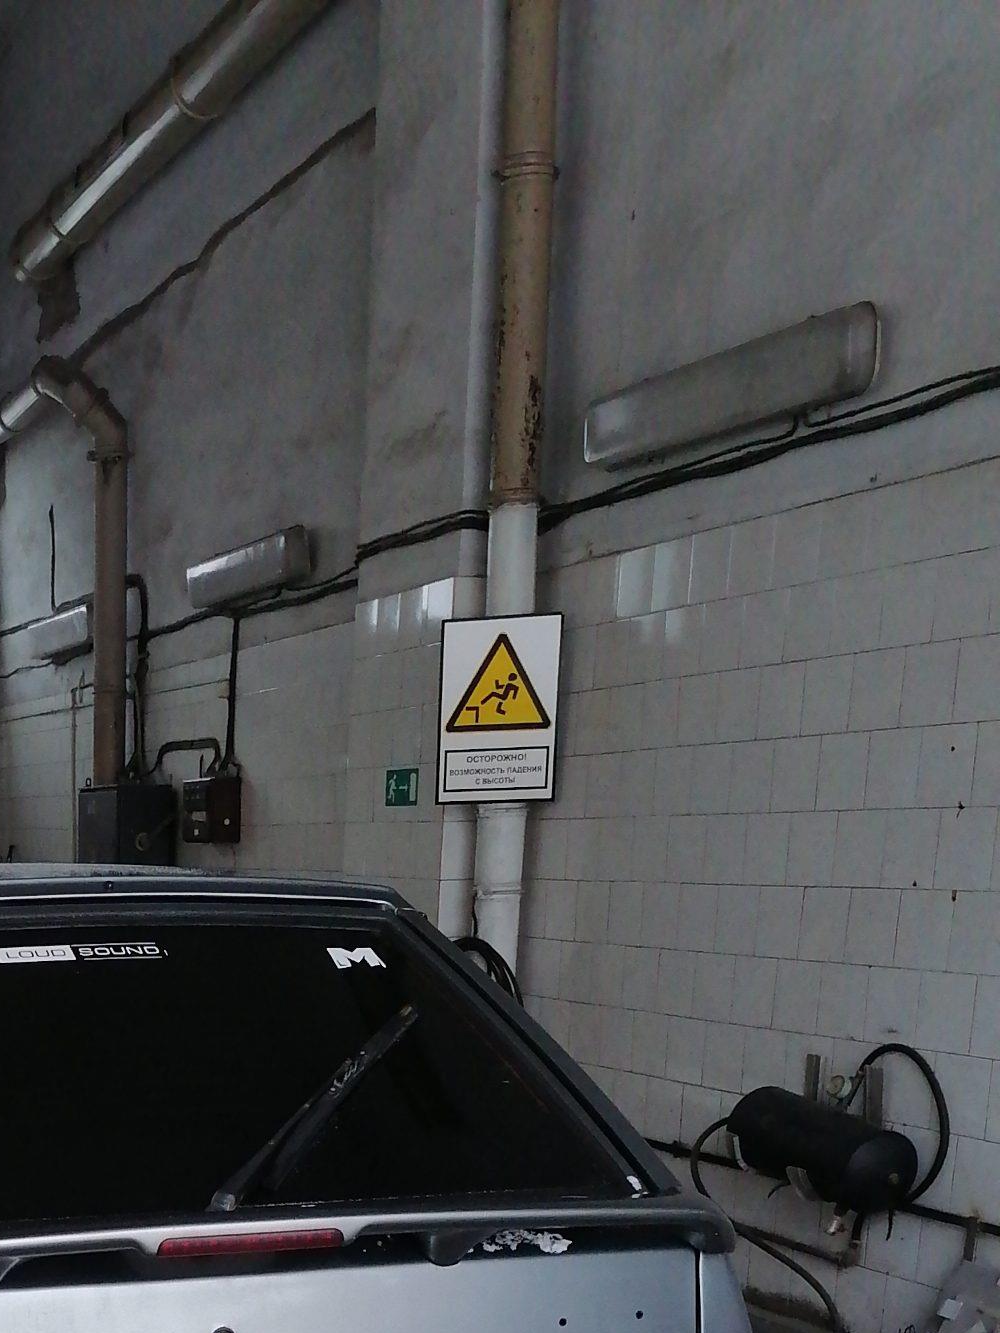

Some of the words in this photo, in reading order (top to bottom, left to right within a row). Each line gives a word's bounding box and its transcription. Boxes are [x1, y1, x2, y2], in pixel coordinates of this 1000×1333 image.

[466, 753, 527, 763] ОСТОРОЖНО!
[449, 767, 505, 776] ВОЗМОЖНОСТЬ
[506, 765, 542, 774] ПАДЕНИЯ
[482, 776, 516, 785] ВЫСОТЫ
[5, 949, 67, 960] LOUD
[78, 945, 160, 957] SOUND
